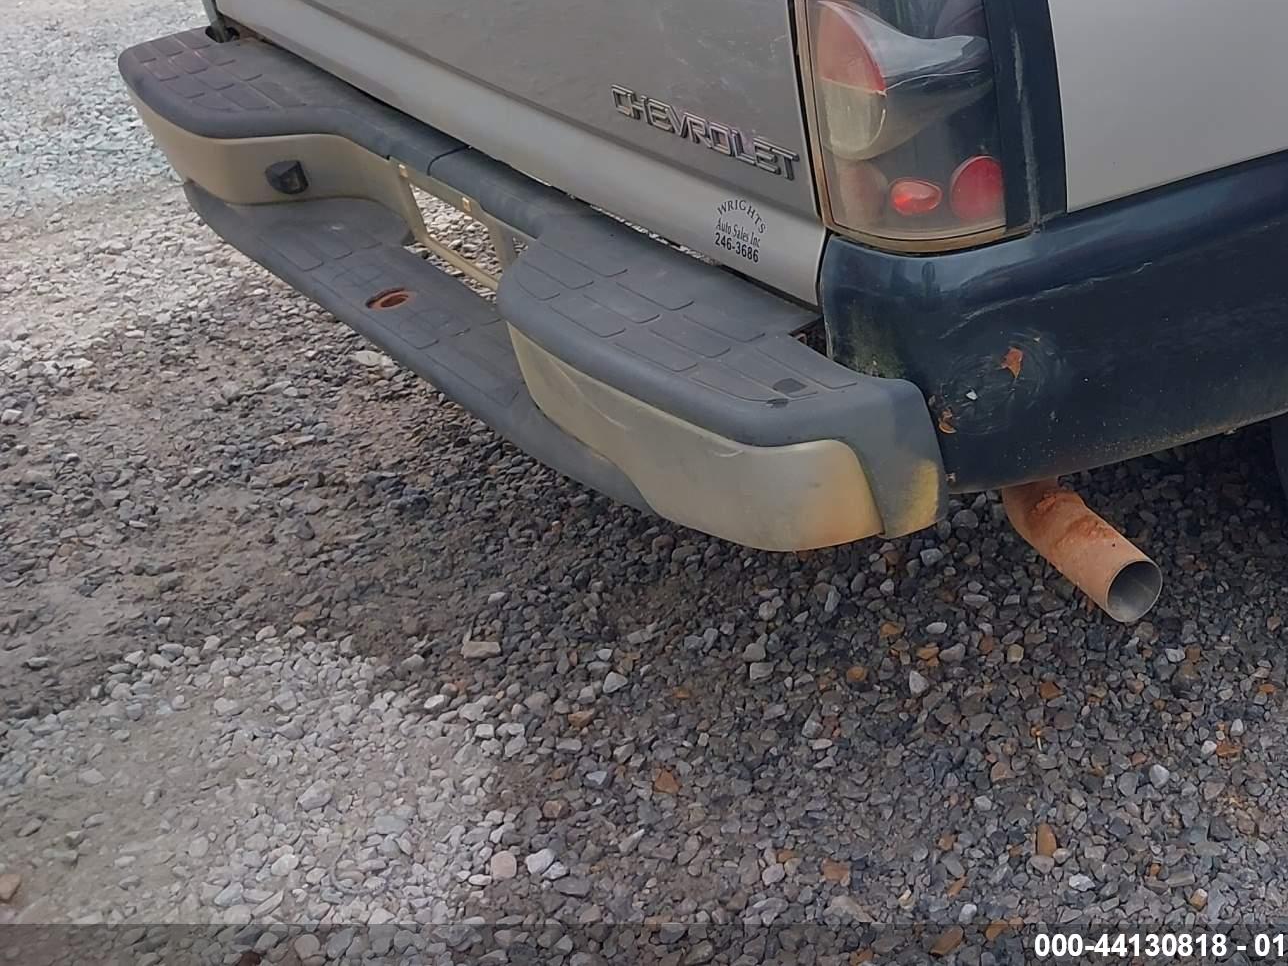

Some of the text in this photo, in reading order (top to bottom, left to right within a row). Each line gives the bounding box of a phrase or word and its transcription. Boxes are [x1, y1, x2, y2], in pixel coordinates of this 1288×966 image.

[611, 84, 799, 181] CHEVROLET
[716, 218, 732, 235] Auto
[733, 224, 749, 242] Sales
[715, 232, 759, 263] 246-3686
